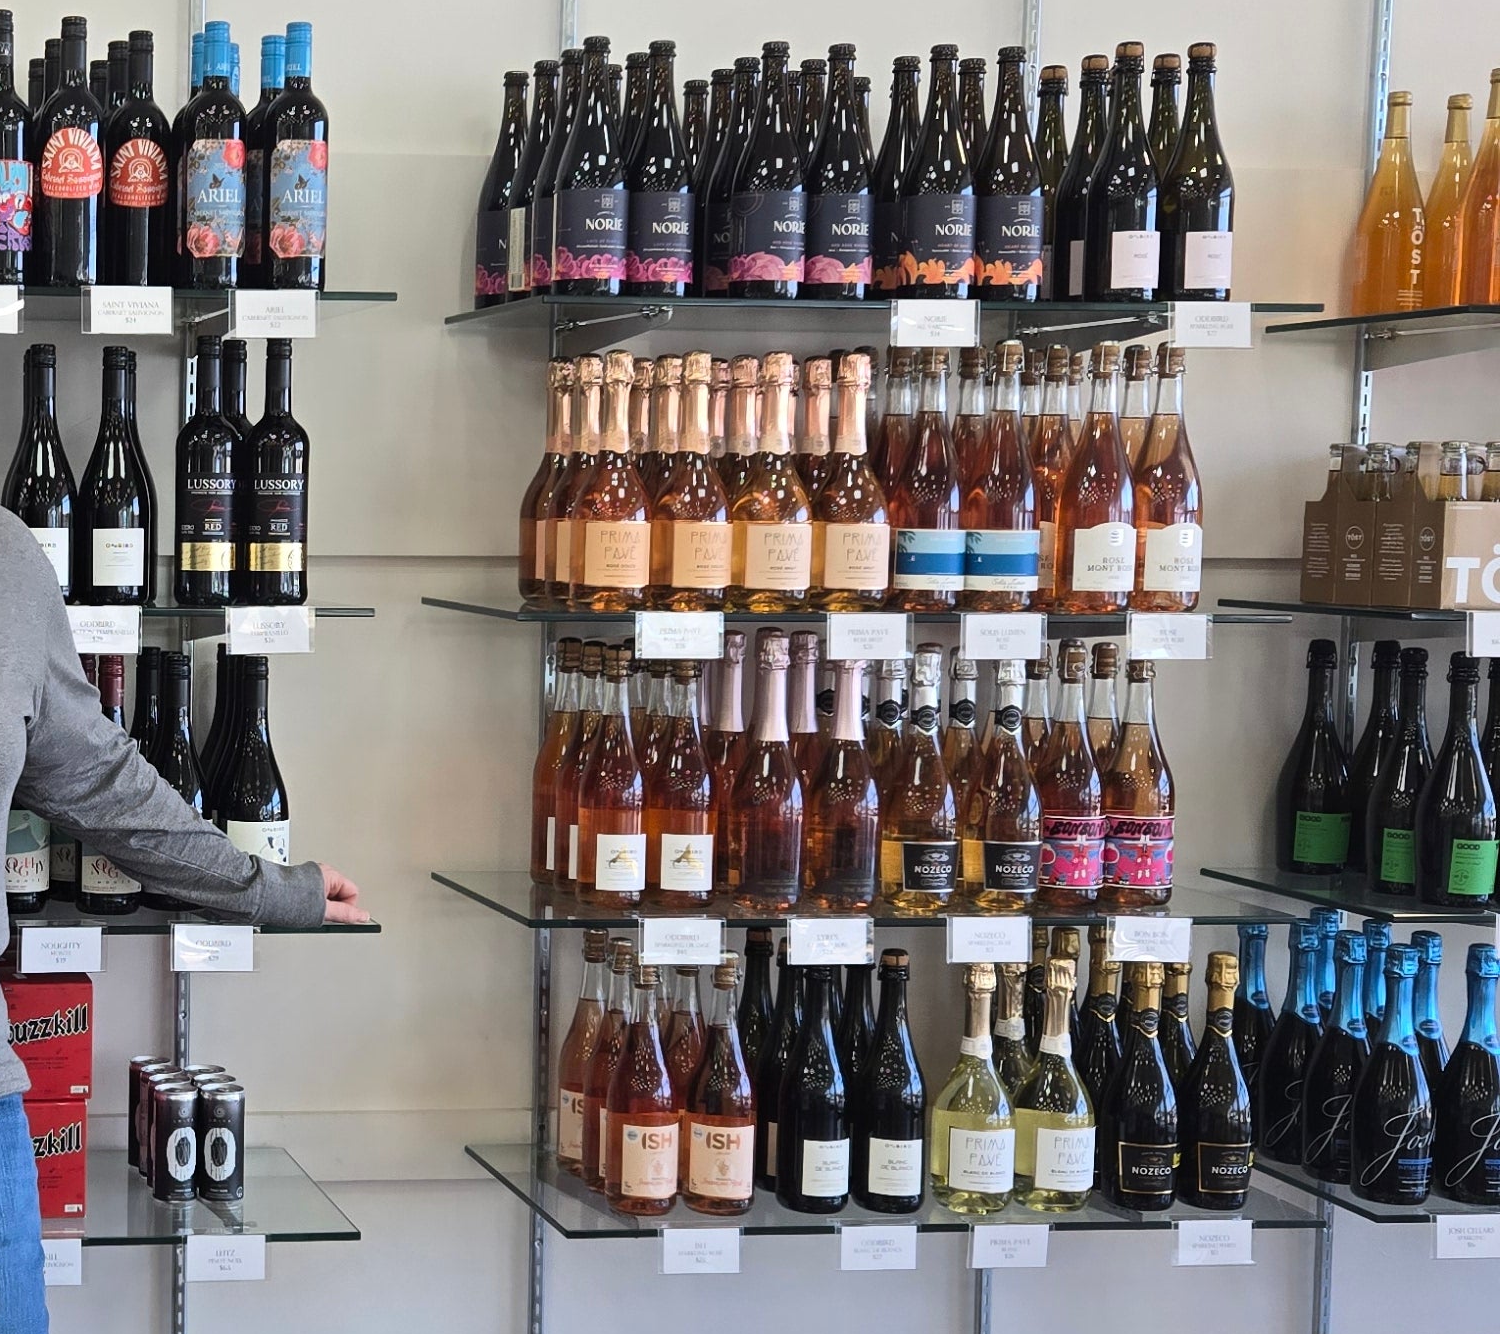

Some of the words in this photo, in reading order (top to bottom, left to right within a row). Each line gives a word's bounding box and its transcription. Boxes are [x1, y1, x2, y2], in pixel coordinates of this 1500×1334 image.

[197, 189, 242, 204] ARIEL
[282, 189, 324, 204] ARIEL
[186, 478, 237, 491] LUSSORY
[253, 478, 305, 491] LUSSORY
[204, 522, 222, 532] RED
[270, 522, 288, 532] RED
[913, 864, 953, 875] NOZECO
[995, 864, 1034, 875] NOZECO
[642, 1131, 673, 1151] ISH
[705, 1130, 741, 1151] ISH
[1131, 1165, 1172, 1176] NOZECO
[1211, 1165, 1248, 1176] NOZECO
